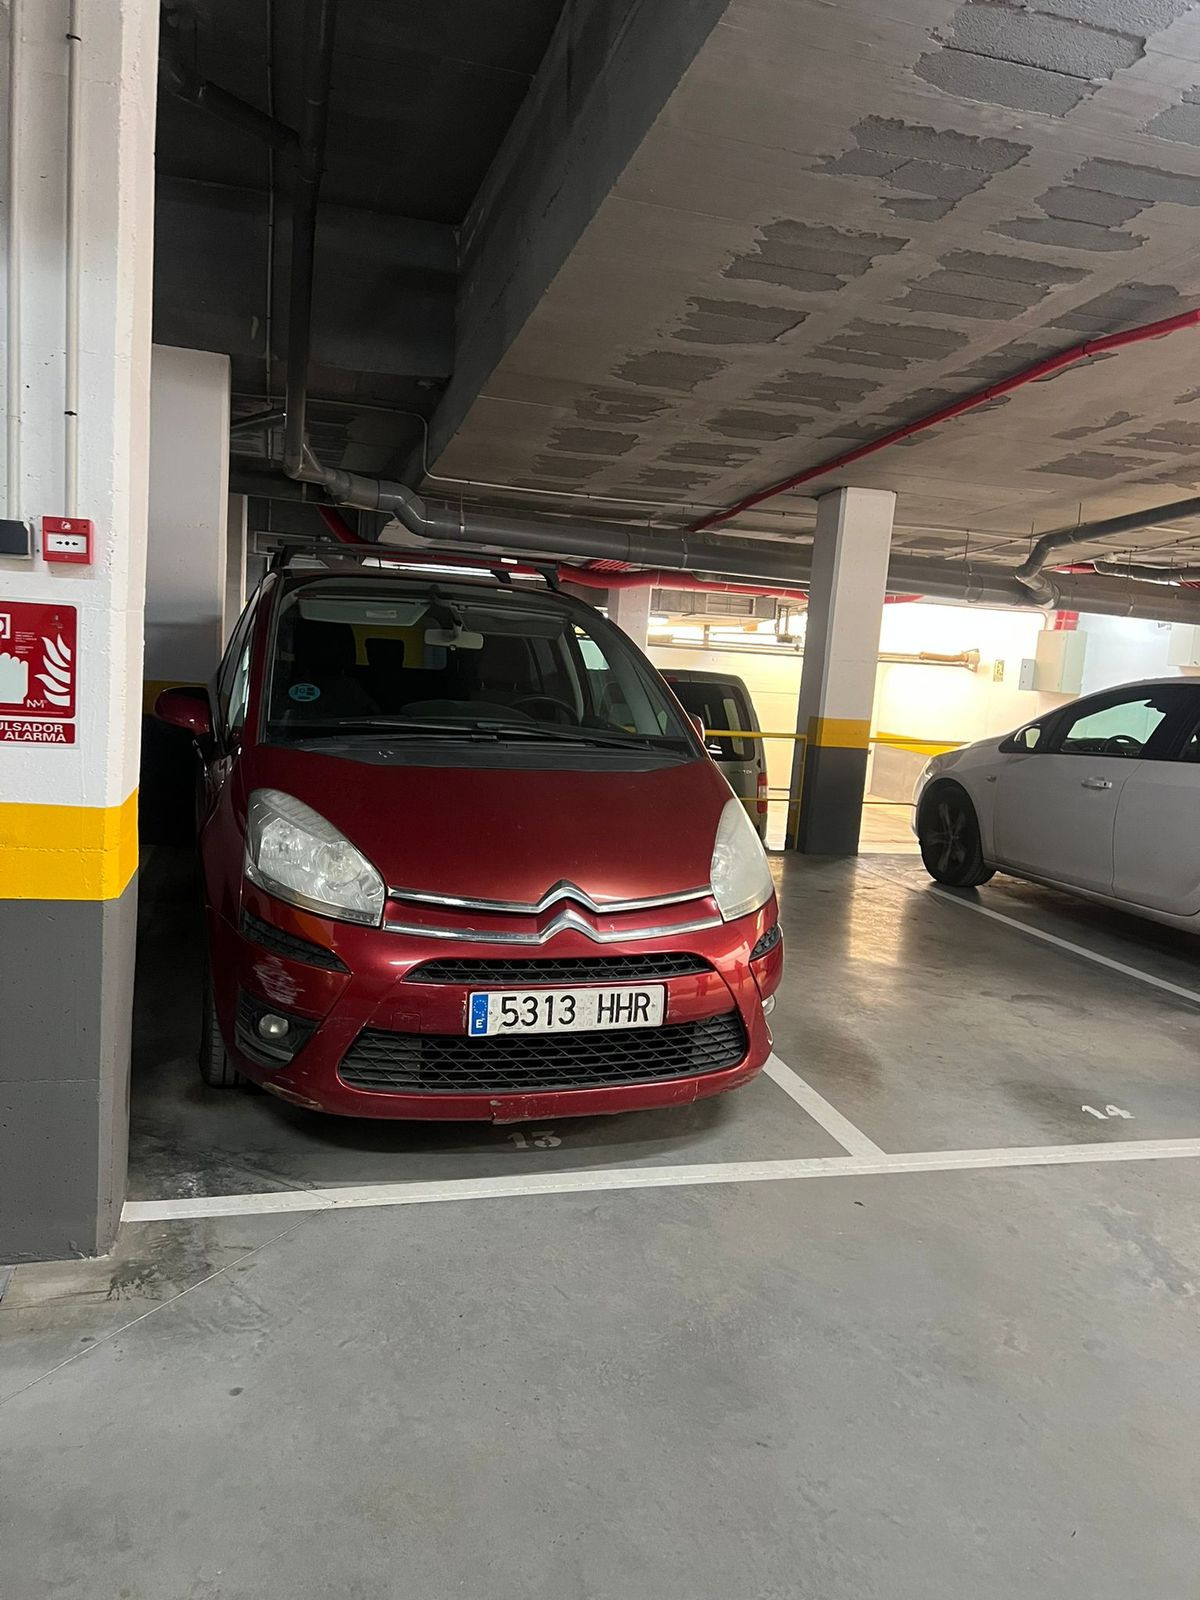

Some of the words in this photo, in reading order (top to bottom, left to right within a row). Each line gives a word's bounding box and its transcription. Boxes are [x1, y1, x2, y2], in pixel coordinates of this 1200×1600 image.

[3, 731, 67, 742] ALARMA
[500, 994, 576, 1027] 5313
[597, 992, 650, 1024] HHR
[475, 1018, 484, 1029] E
[1081, 1104, 1136, 1119] 14
[507, 1130, 562, 1148] 13
